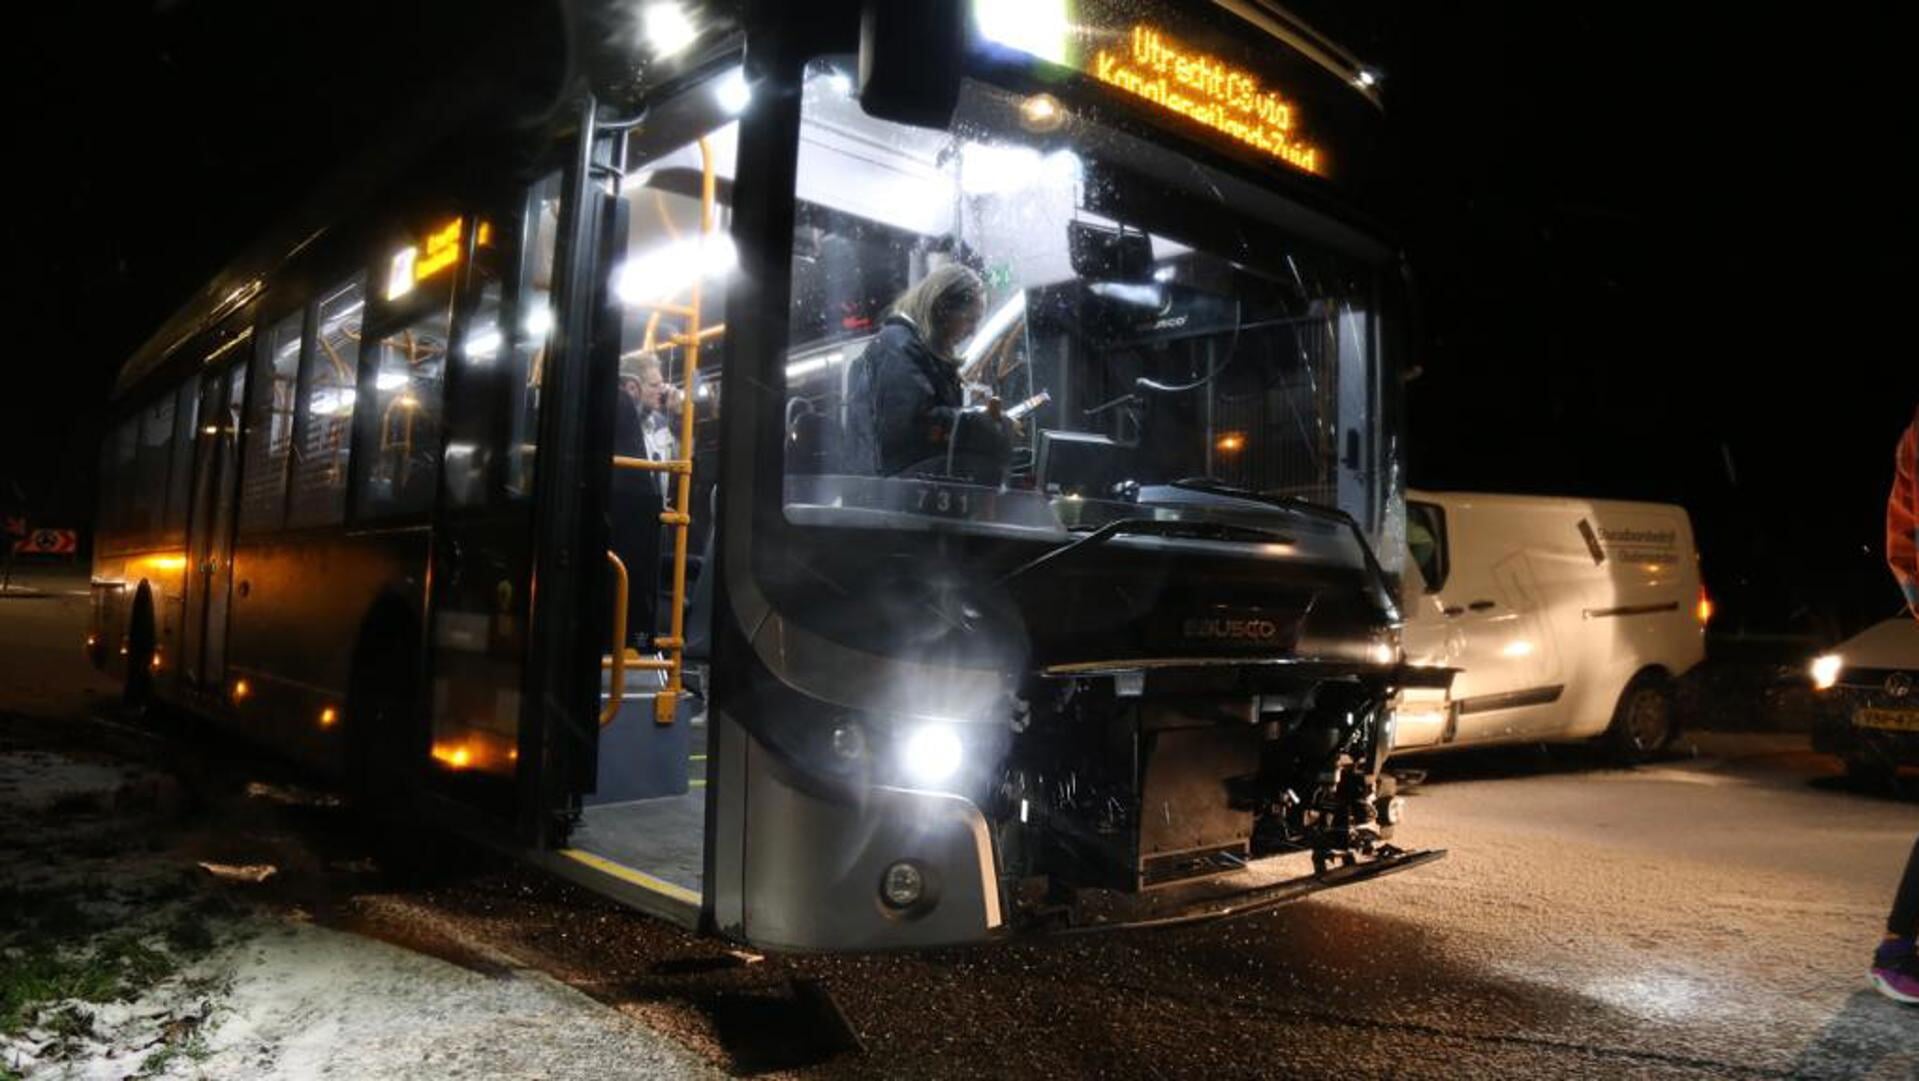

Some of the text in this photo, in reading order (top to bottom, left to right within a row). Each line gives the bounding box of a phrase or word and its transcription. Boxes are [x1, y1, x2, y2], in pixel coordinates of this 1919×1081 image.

[1133, 26, 1290, 131] Utrecht CS via
[917, 488, 968, 513] 731
